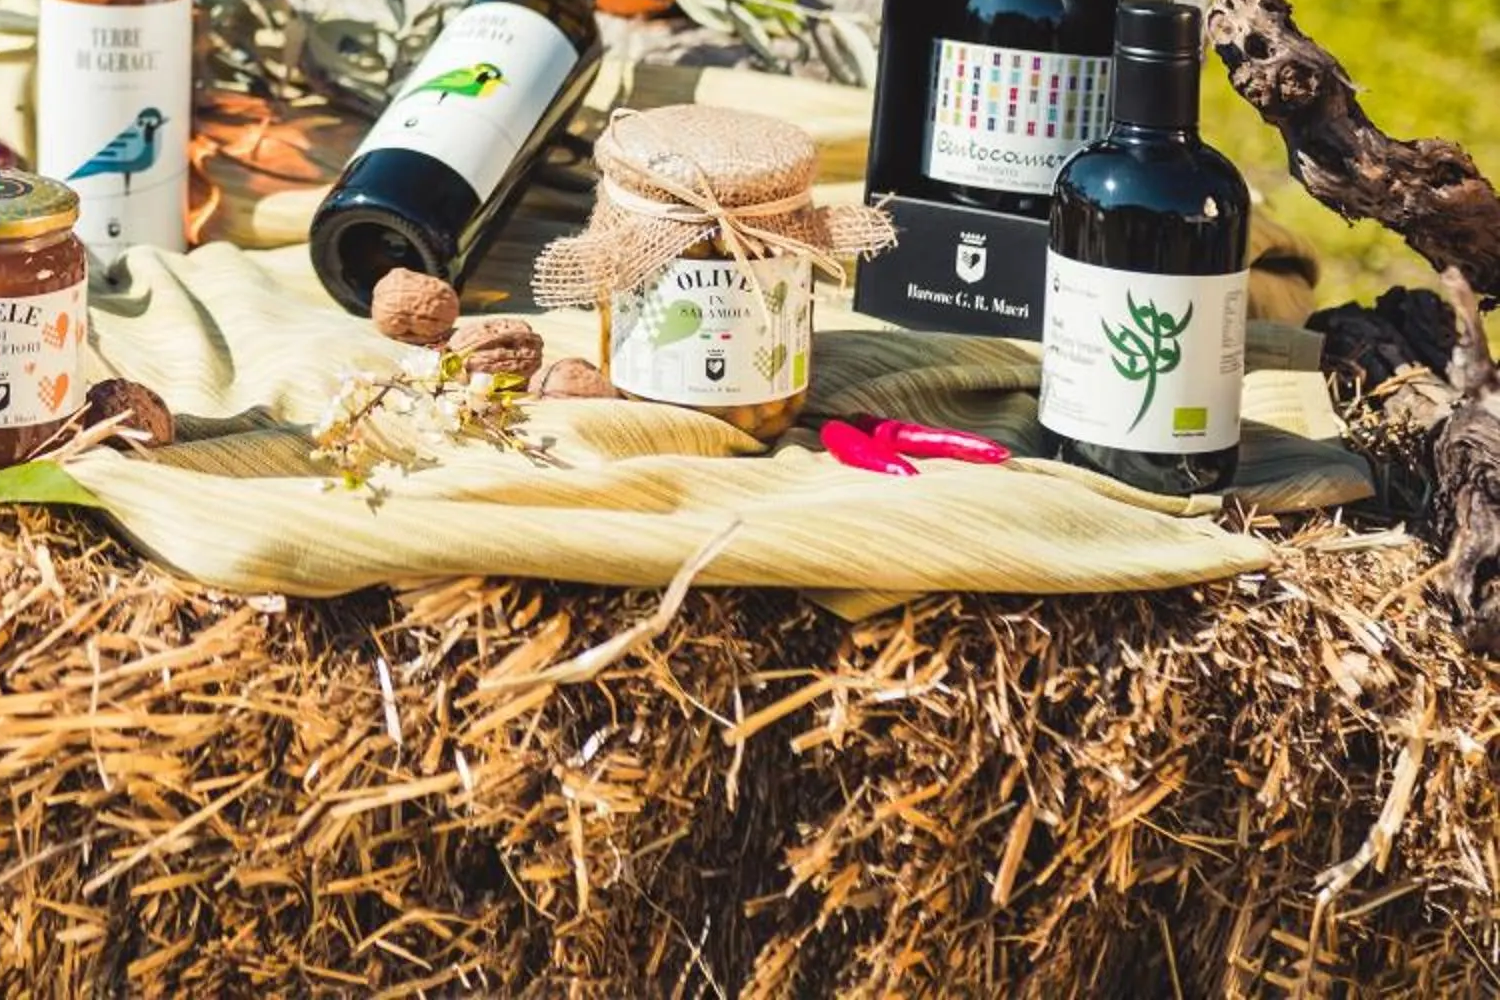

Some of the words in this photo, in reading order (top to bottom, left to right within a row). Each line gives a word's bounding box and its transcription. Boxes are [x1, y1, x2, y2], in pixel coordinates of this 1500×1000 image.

[91, 26, 143, 49] TERRE
[97, 50, 159, 73] GERACE
[677, 269, 754, 293] OLIVE
[709, 295, 724, 305] IN
[907, 282, 954, 305] Barone
[679, 307, 751, 319] SALAMOIA
